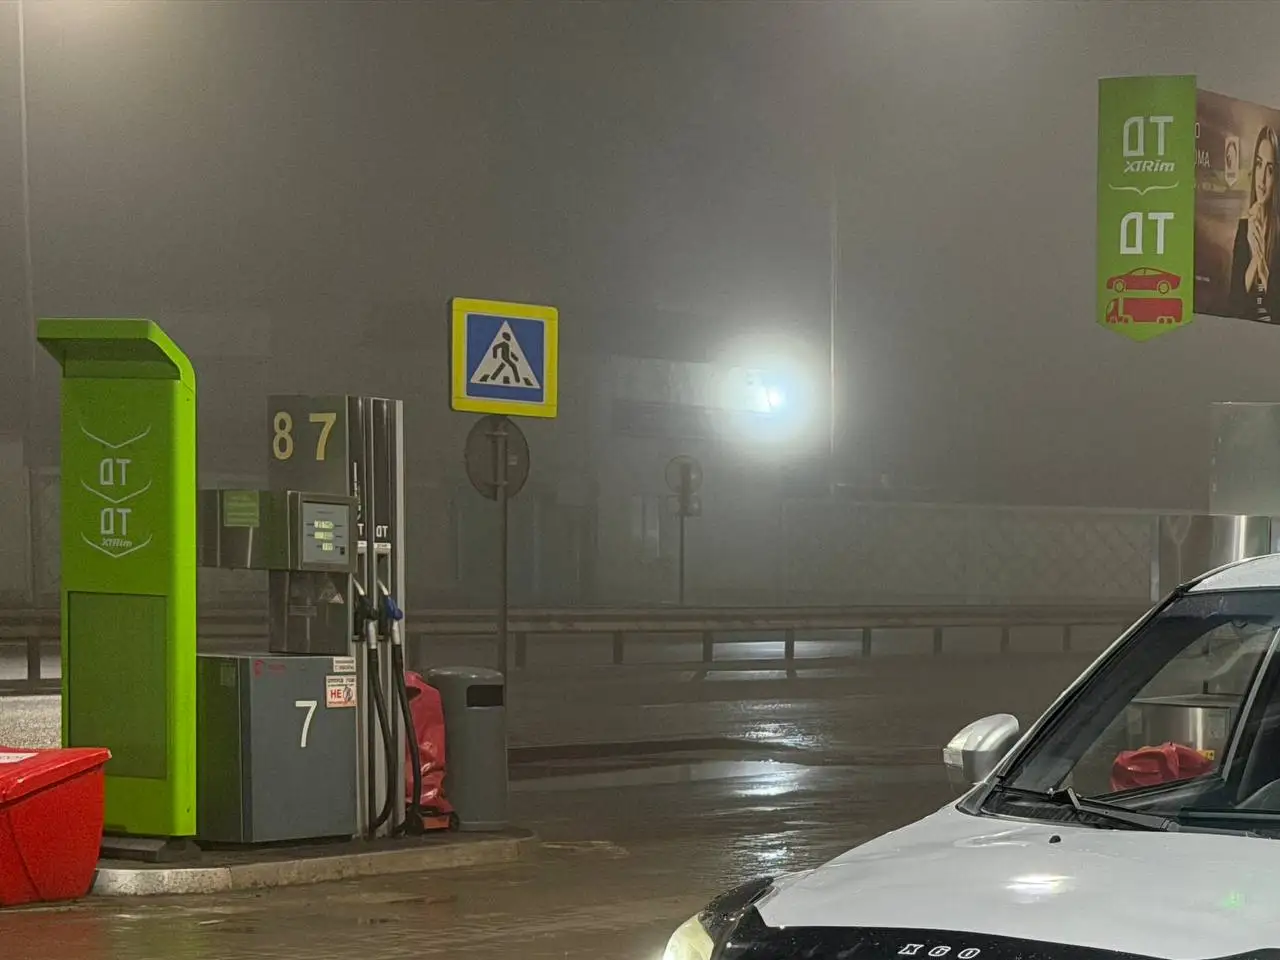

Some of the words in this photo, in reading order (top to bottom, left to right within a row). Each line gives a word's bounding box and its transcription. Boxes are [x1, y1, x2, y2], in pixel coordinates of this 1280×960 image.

[1123, 116, 1174, 157] ДТ
[1120, 212, 1174, 255] ДТ
[272, 411, 294, 460] 8
[309, 412, 337, 461] 7
[100, 458, 131, 486] ДТ
[101, 508, 132, 536] ДТ
[295, 700, 318, 748] 7
[898, 943, 981, 959] X60
